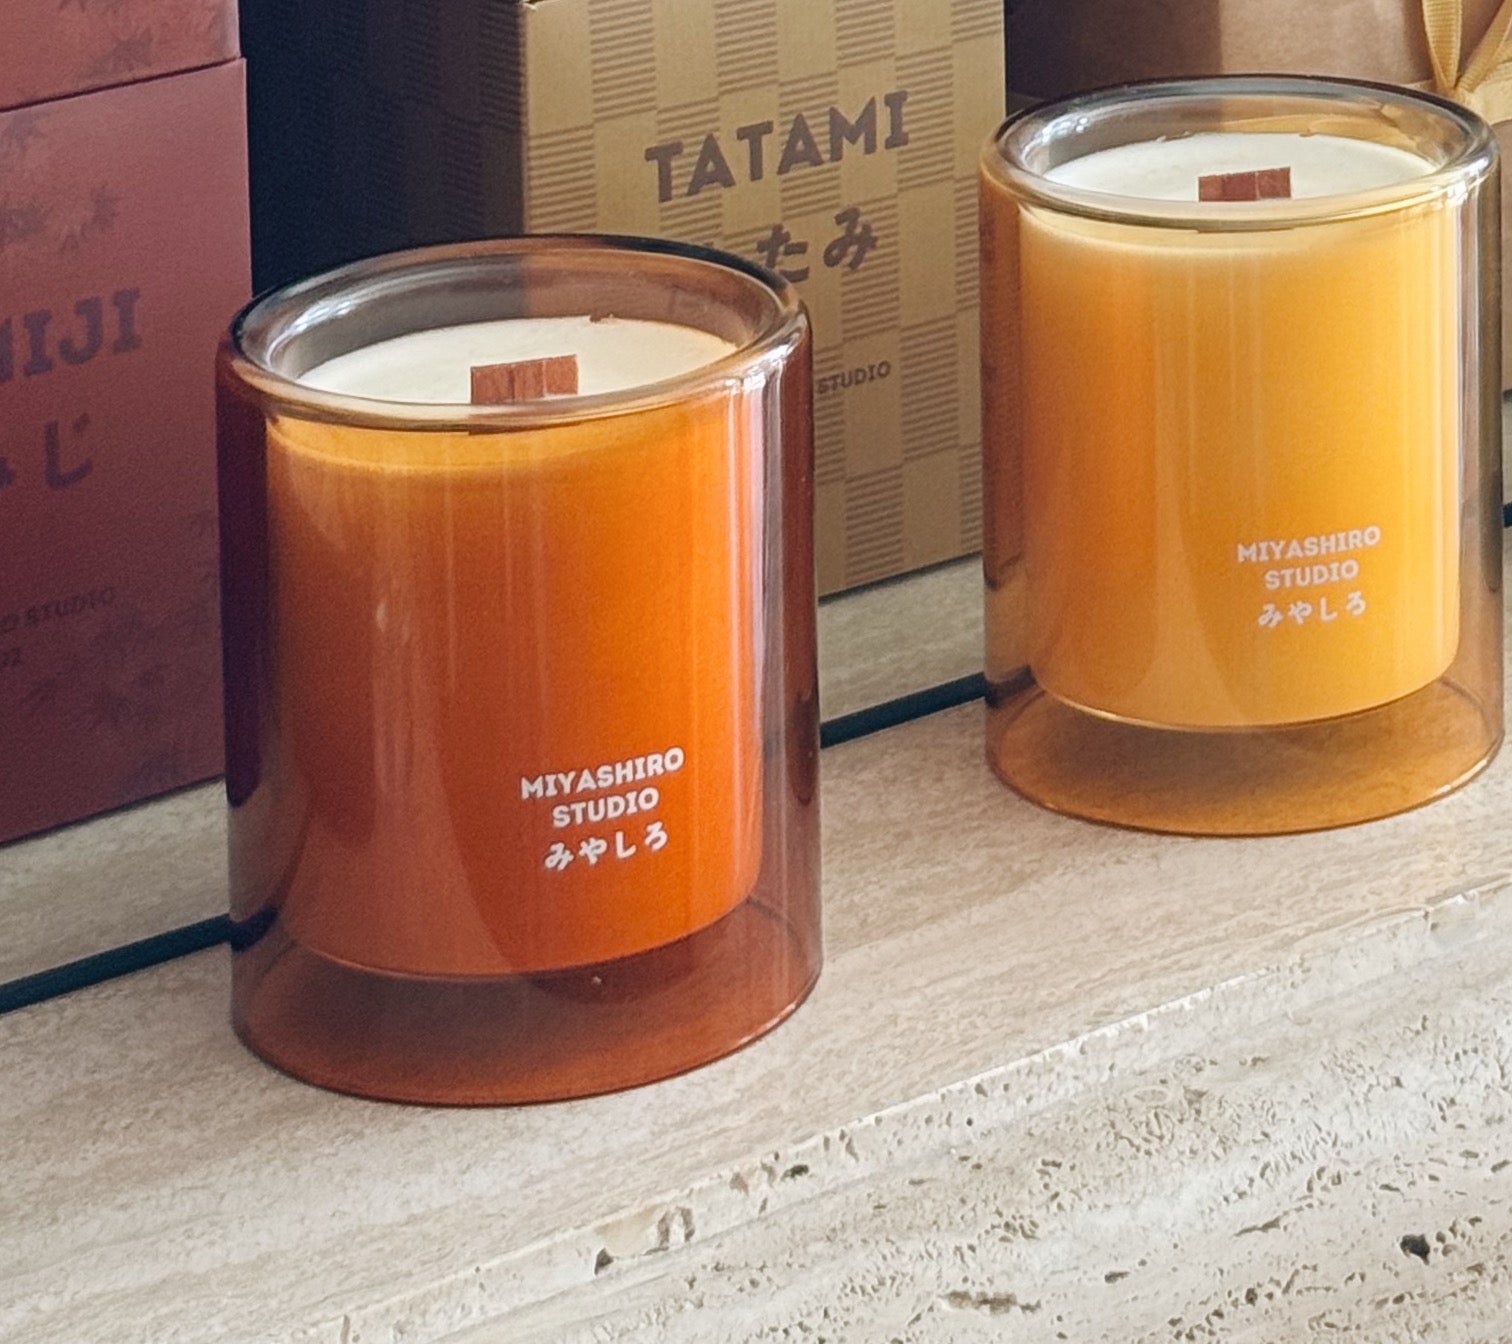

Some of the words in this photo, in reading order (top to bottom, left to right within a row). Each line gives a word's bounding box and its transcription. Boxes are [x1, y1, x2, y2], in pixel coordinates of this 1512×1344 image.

[645, 89, 909, 204] TATAMI
[755, 206, 878, 285] たみ
[816, 359, 892, 395] STUDIO
[1237, 525, 1382, 564] MIYASHIRO
[1264, 558, 1360, 591] STUDIO
[1257, 589, 1368, 629] みやしろ
[520, 746, 685, 800] MIYASHIRO
[551, 786, 661, 829] STUDIO
[544, 820, 670, 872] みやしろ
